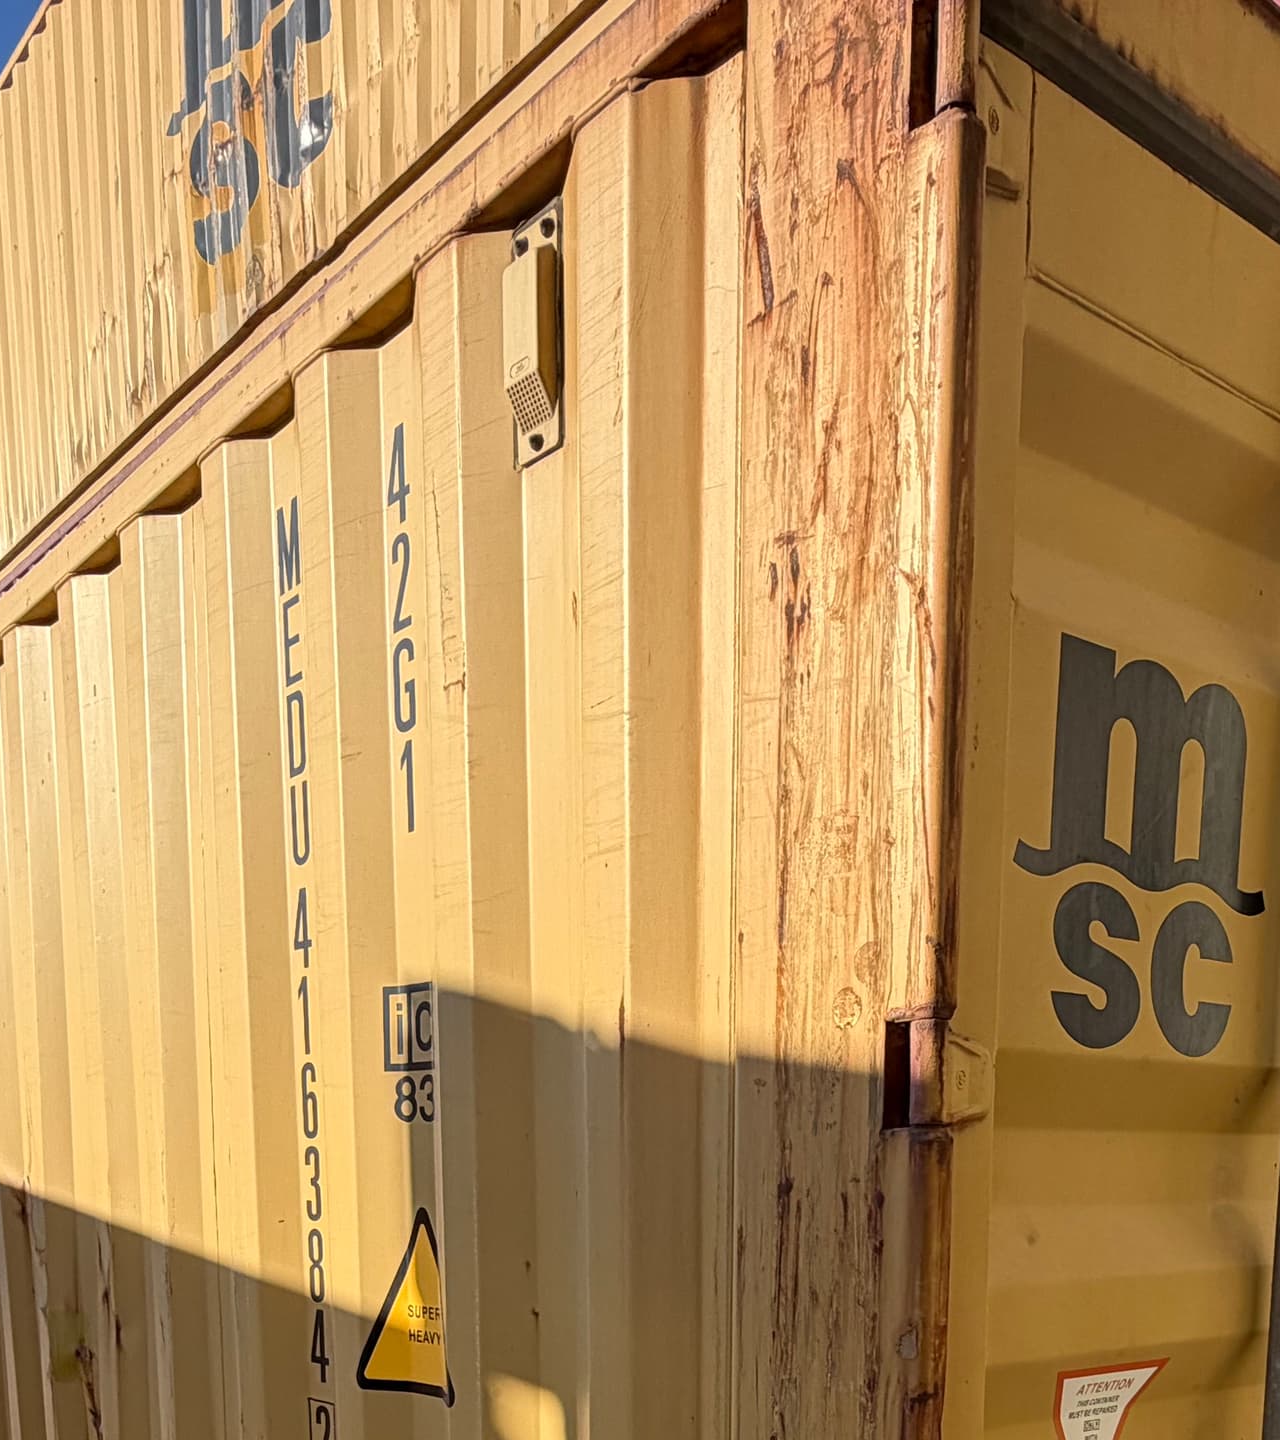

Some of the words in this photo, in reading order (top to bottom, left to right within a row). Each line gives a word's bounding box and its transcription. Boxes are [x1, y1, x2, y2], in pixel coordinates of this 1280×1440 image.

[388, 422, 416, 833] 42G1
[276, 495, 310, 866] MEDU
[294, 887, 330, 1383] 416384
[394, 1074, 435, 1122] 83
[408, 1304, 441, 1321] SUPER
[408, 1329, 441, 1346] HEAVY
[1076, 1377, 1135, 1396] ATTENTION
